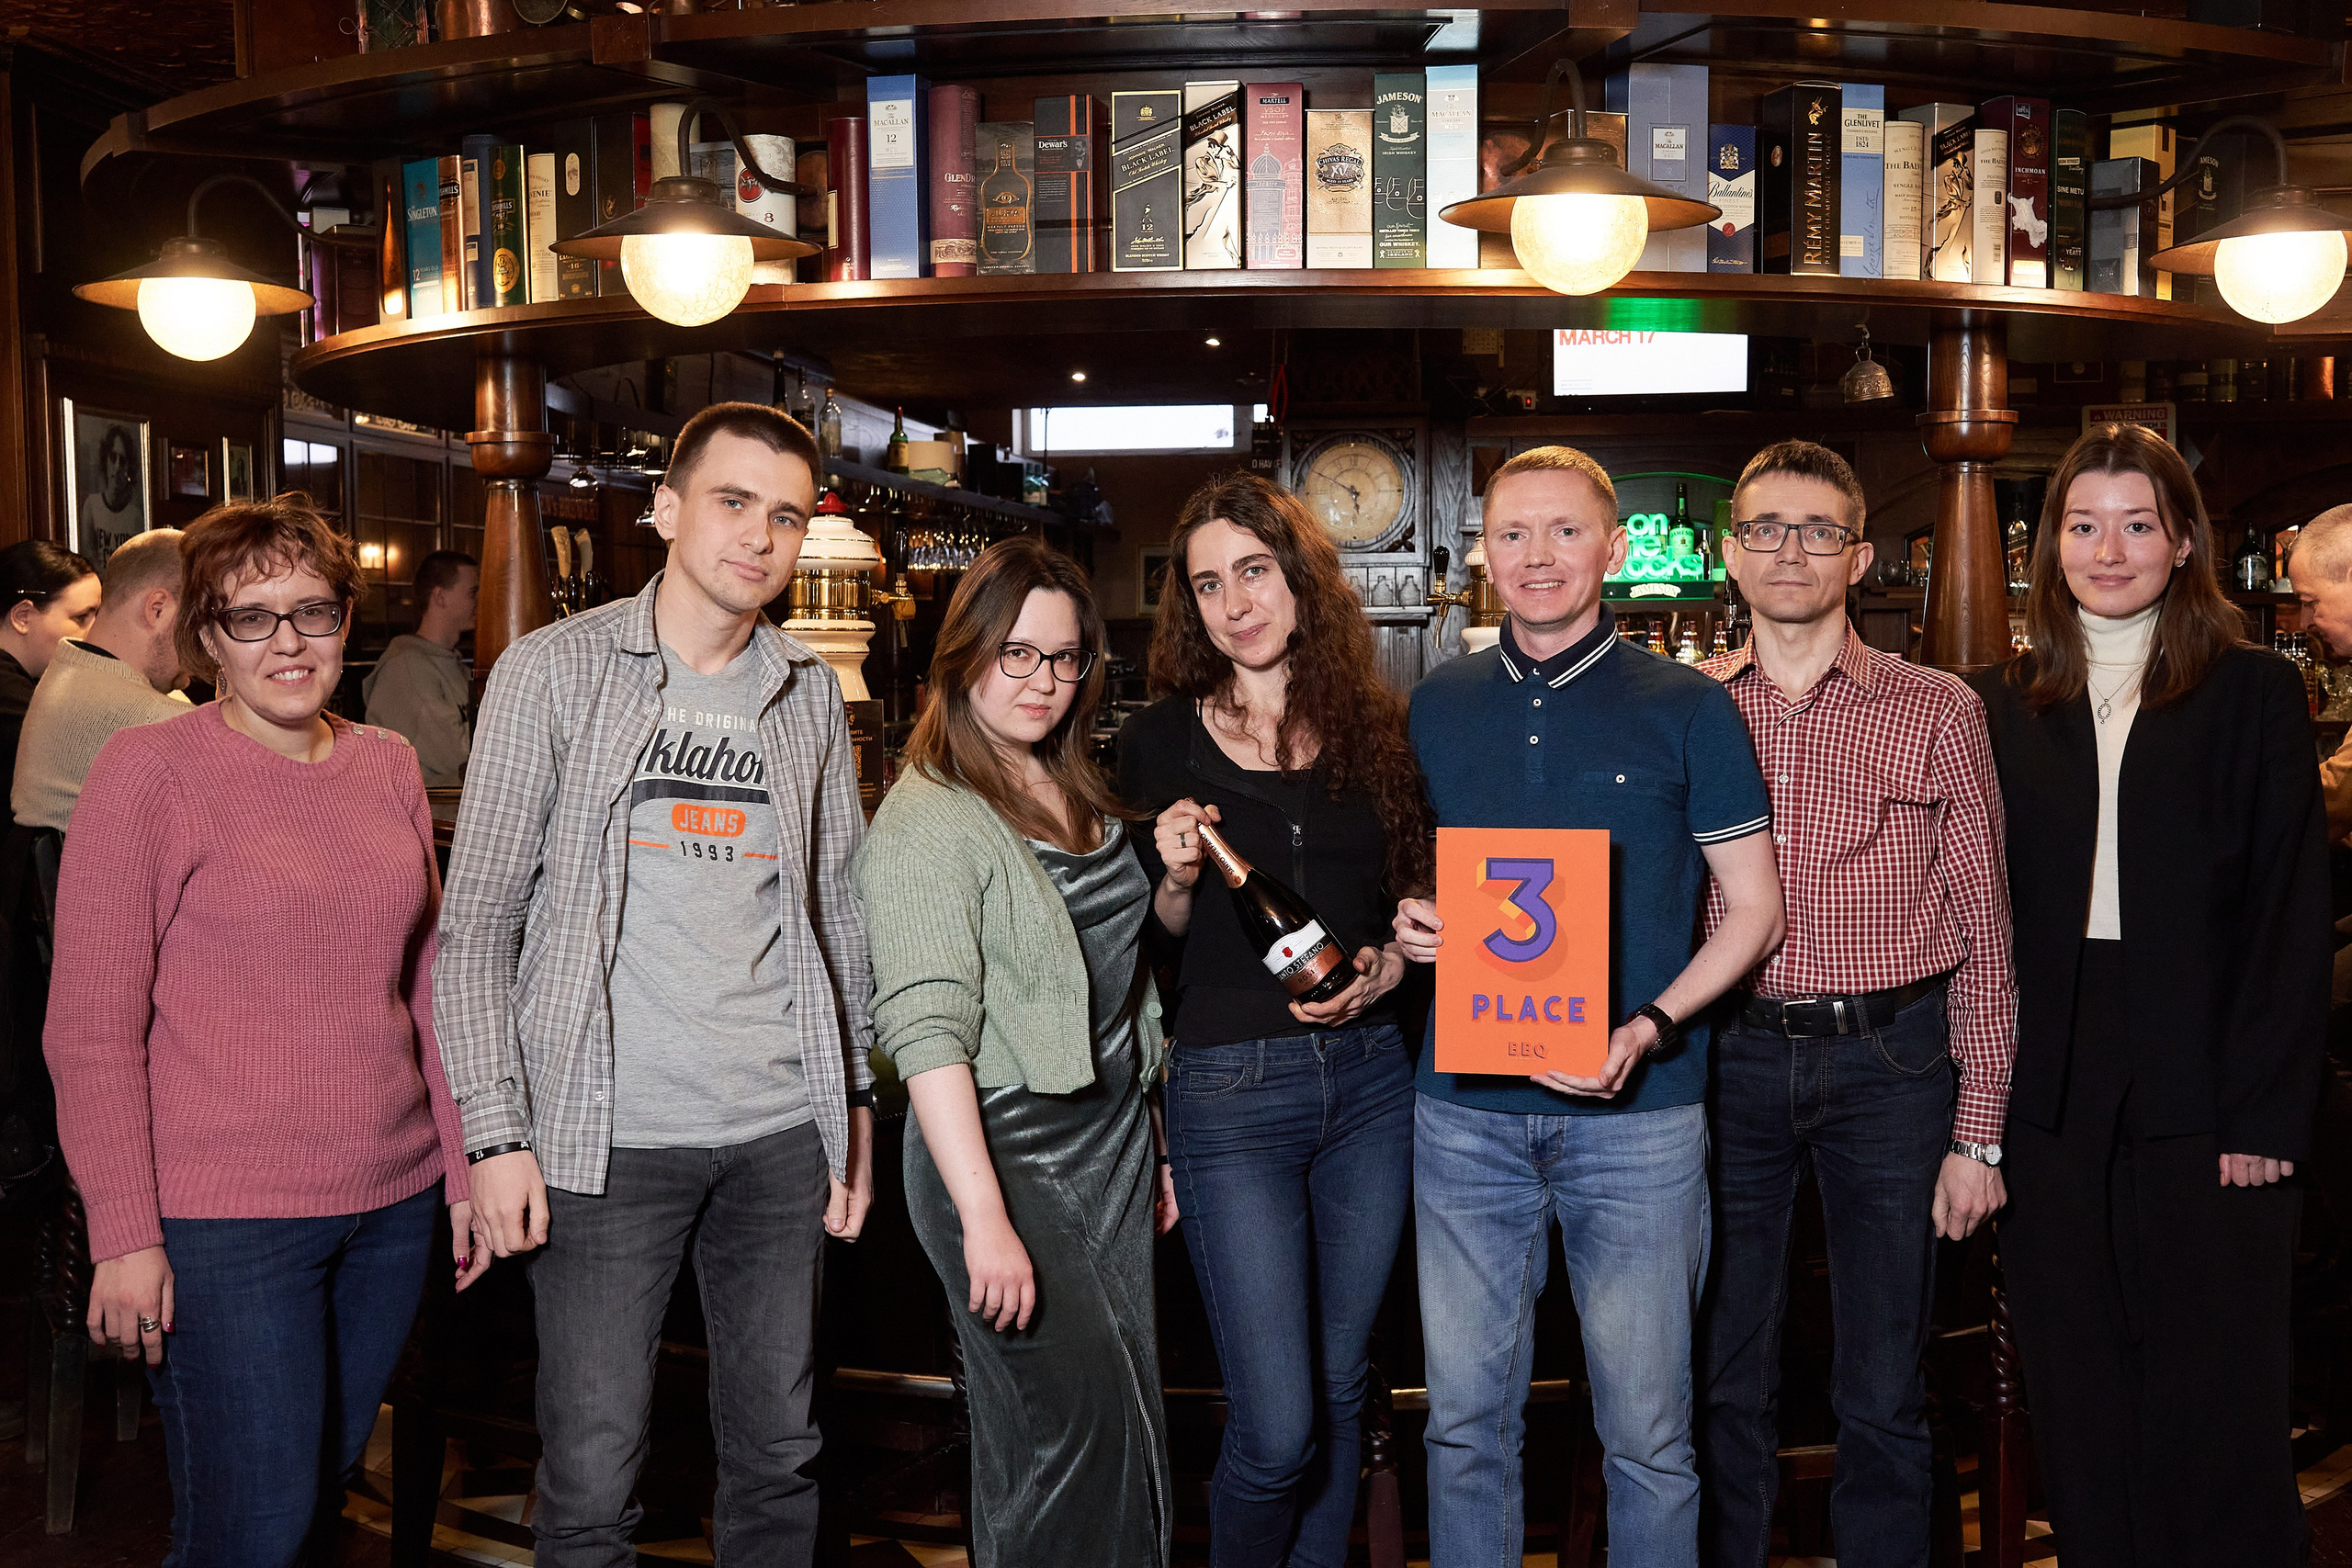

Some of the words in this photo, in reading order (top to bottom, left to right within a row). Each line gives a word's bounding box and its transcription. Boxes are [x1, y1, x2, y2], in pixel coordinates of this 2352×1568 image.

[1376, 92, 1421, 105] JAMESON
[874, 118, 909, 127] MACALLAN
[1189, 116, 1213, 132] BLACK
[1845, 119, 1880, 129] GLENLIVET
[886, 134, 897, 143] 12
[1038, 140, 1068, 149] Dewar's
[1121, 156, 1148, 172] BLACK
[1318, 156, 1340, 165] CHIVAS
[1341, 156, 1362, 166] REGAL
[1903, 161, 1922, 170] BALV
[2199, 156, 2220, 169] AMESON
[1330, 164, 1349, 178] XV
[1804, 132, 1823, 208] MARTIN
[944, 173, 976, 184] GLENDR
[439, 185, 458, 197] SHMILLS
[529, 189, 550, 198] VENIE
[1708, 181, 1753, 198] Ballantine's
[2070, 186, 2085, 196] METU
[407, 206, 437, 222] SINGLETON
[764, 212, 774, 222] 8
[1804, 213, 1822, 265] RÉMY
[413, 269, 421, 281] 12
[1559, 329, 1632, 345] MARCH
[1637, 331, 1656, 344] 17
[2103, 408, 2165, 421] WARNING
[1627, 513, 1668, 536] on
[1669, 530, 1694, 538] JAMESON
[1623, 546, 1703, 577] ocks
[1630, 584, 1679, 597] JAMESON
[667, 707, 686, 724] HE
[695, 711, 756, 733] ORIGINA
[641, 728, 766, 786] klaho
[680, 808, 739, 834] JEANS
[680, 840, 734, 862] 1993
[1200, 832, 1222, 858] STEFANO
[1220, 856, 1235, 875] SANTO
[1476, 857, 1557, 966] 3
[1277, 965, 1295, 981] SANTO
[1294, 941, 1325, 970] STEFANO
[1472, 994, 1586, 1023] PLACE
[1508, 1042, 1547, 1059] BBQ
